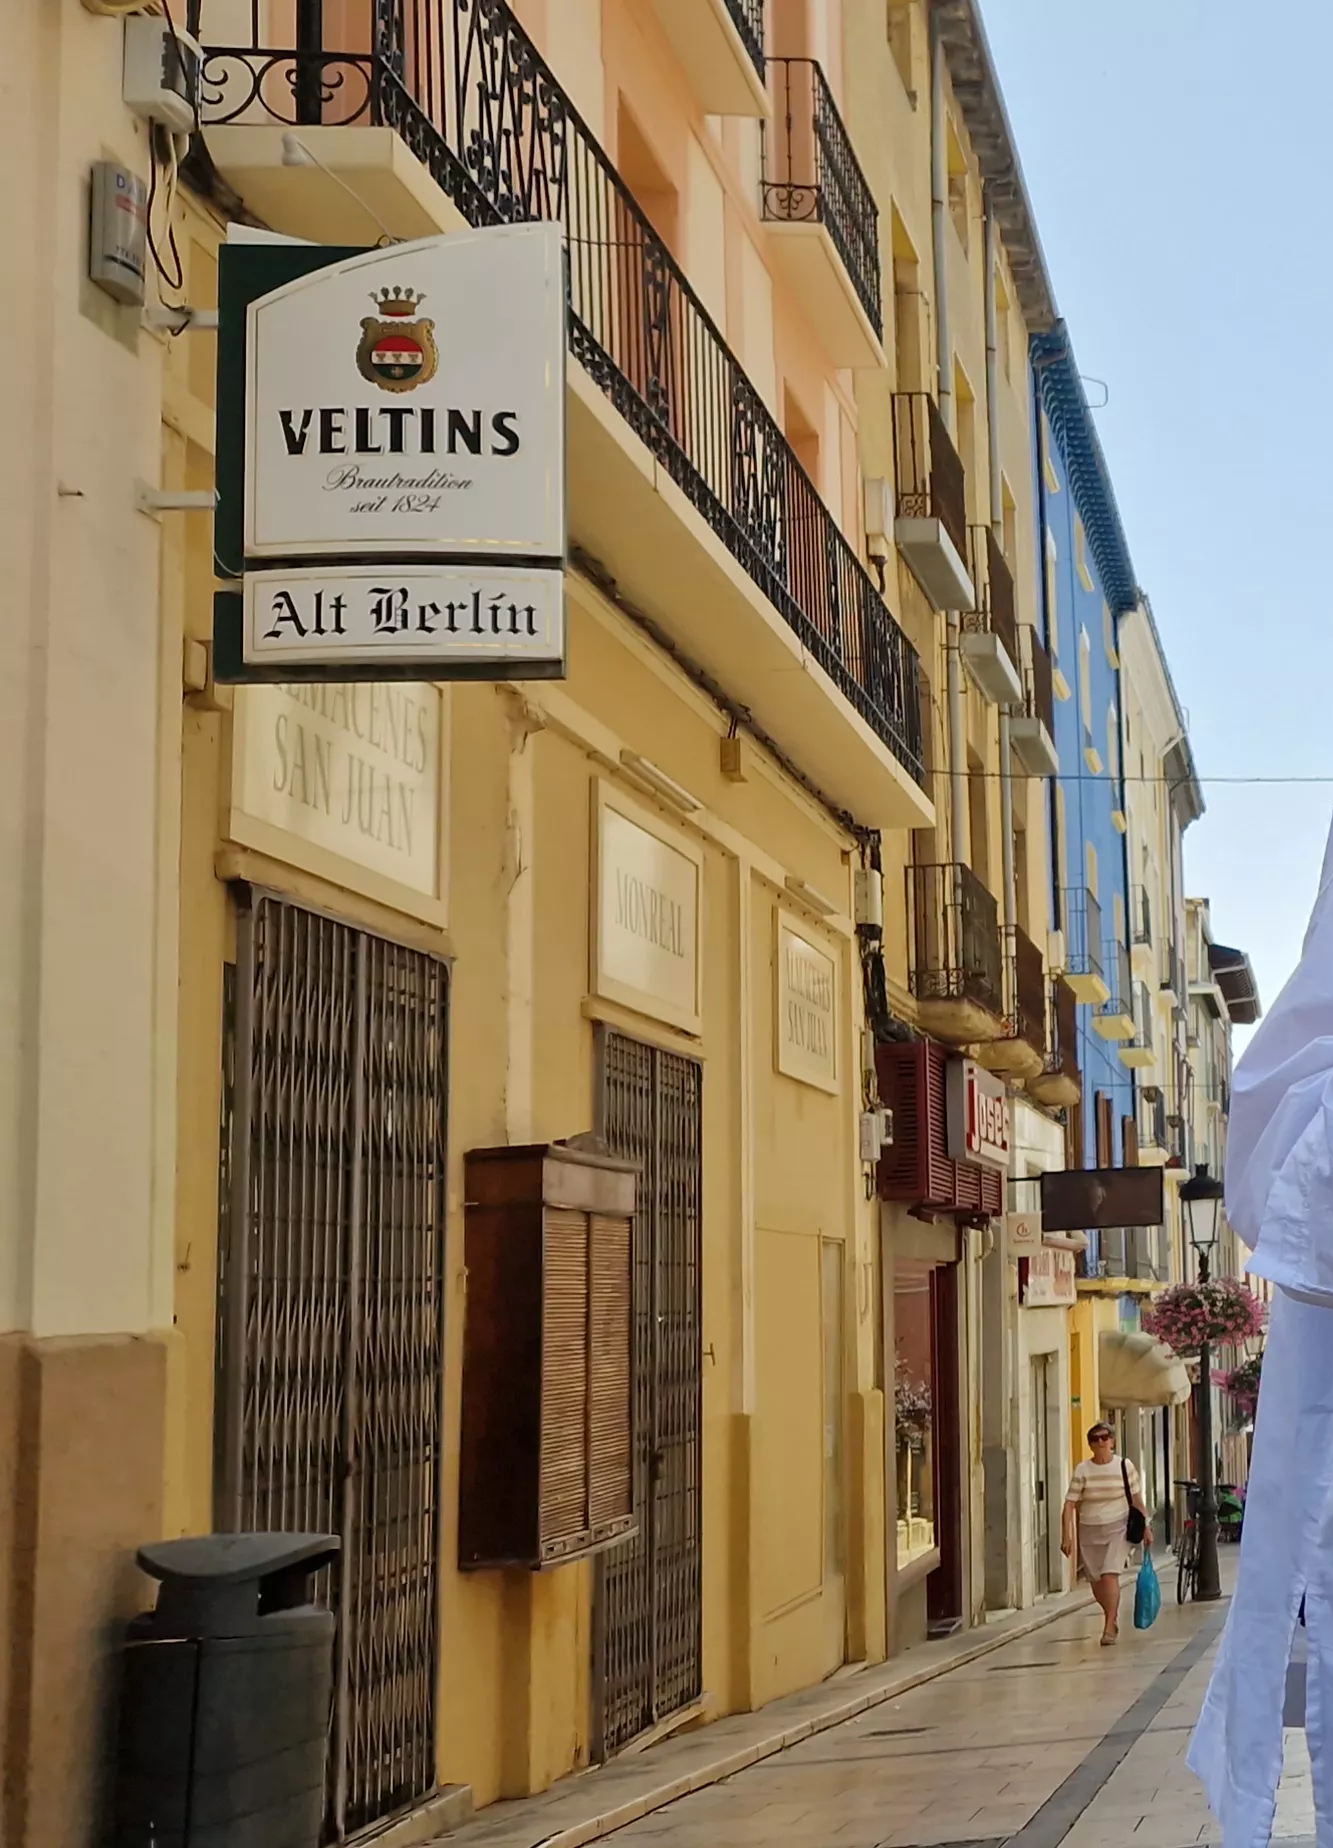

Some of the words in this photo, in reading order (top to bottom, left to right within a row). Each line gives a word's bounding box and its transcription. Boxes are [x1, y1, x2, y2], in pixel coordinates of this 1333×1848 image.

[279, 407, 520, 456] VELTINS
[322, 463, 473, 491] Brautradition
[349, 495, 387, 513] seit
[391, 494, 443, 513] 1824
[262, 589, 347, 640] Alt
[273, 714, 332, 816] SAN
[341, 752, 415, 857] JUAN
[615, 867, 684, 958] MONREAL
